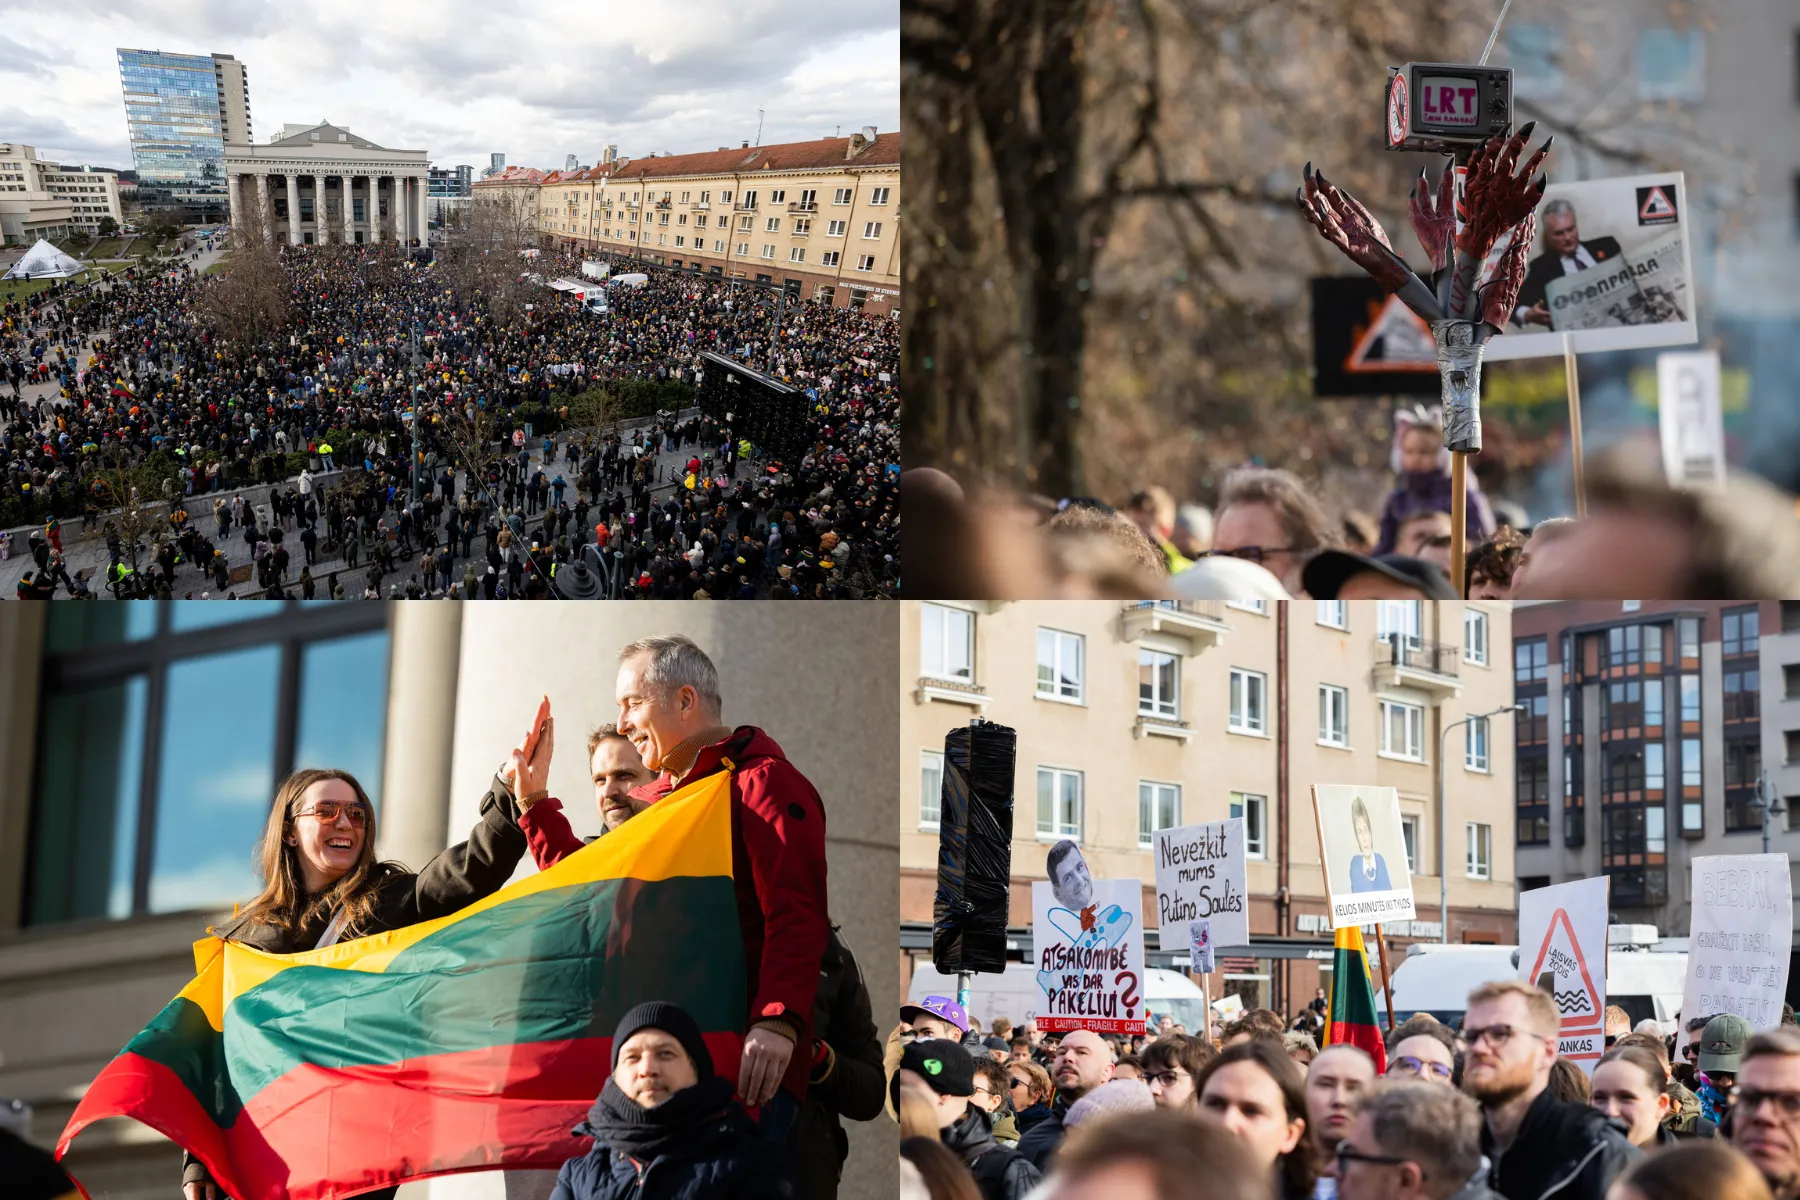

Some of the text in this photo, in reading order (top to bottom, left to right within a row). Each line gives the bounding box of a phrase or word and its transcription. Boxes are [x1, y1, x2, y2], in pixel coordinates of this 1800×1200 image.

[1424, 86, 1477, 114] LRT
[1161, 824, 1228, 869] Nevežkit
[1178, 864, 1215, 883] mums
[1159, 889, 1197, 926] Putino
[1335, 903, 1358, 917] KELIOS
[1393, 898, 1411, 909] TYLOS
[1548, 945, 1577, 971] LAISVAS
[1548, 957, 1570, 979] ŽODIS
[1062, 974, 1103, 989] VIS DAR
[1709, 966, 1723, 981] NE
[1558, 1039, 1593, 1053] ANKAS
